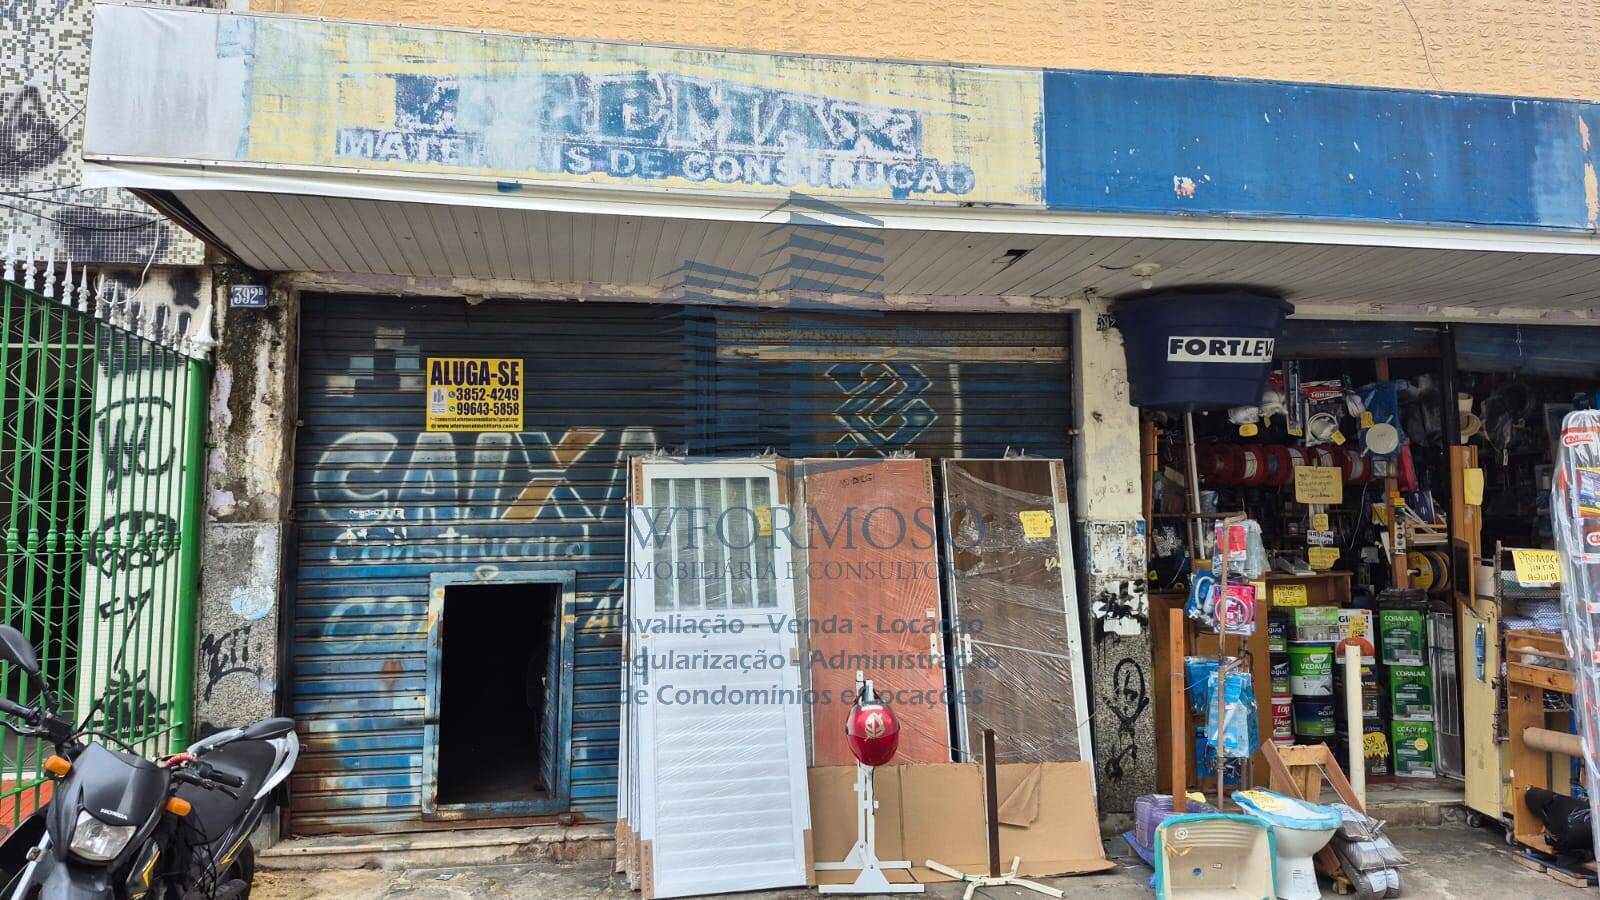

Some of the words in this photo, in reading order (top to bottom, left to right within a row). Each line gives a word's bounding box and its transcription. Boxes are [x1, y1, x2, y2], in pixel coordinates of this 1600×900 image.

[338, 128, 592, 174] MATEIS
[1170, 338, 1274, 356] FORTLEV
[430, 361, 519, 386] ALUGA-SE
[456, 388, 519, 401] 3852-4249
[457, 402, 519, 416] 99643-5858
[100, 808, 128, 820] HONDA
